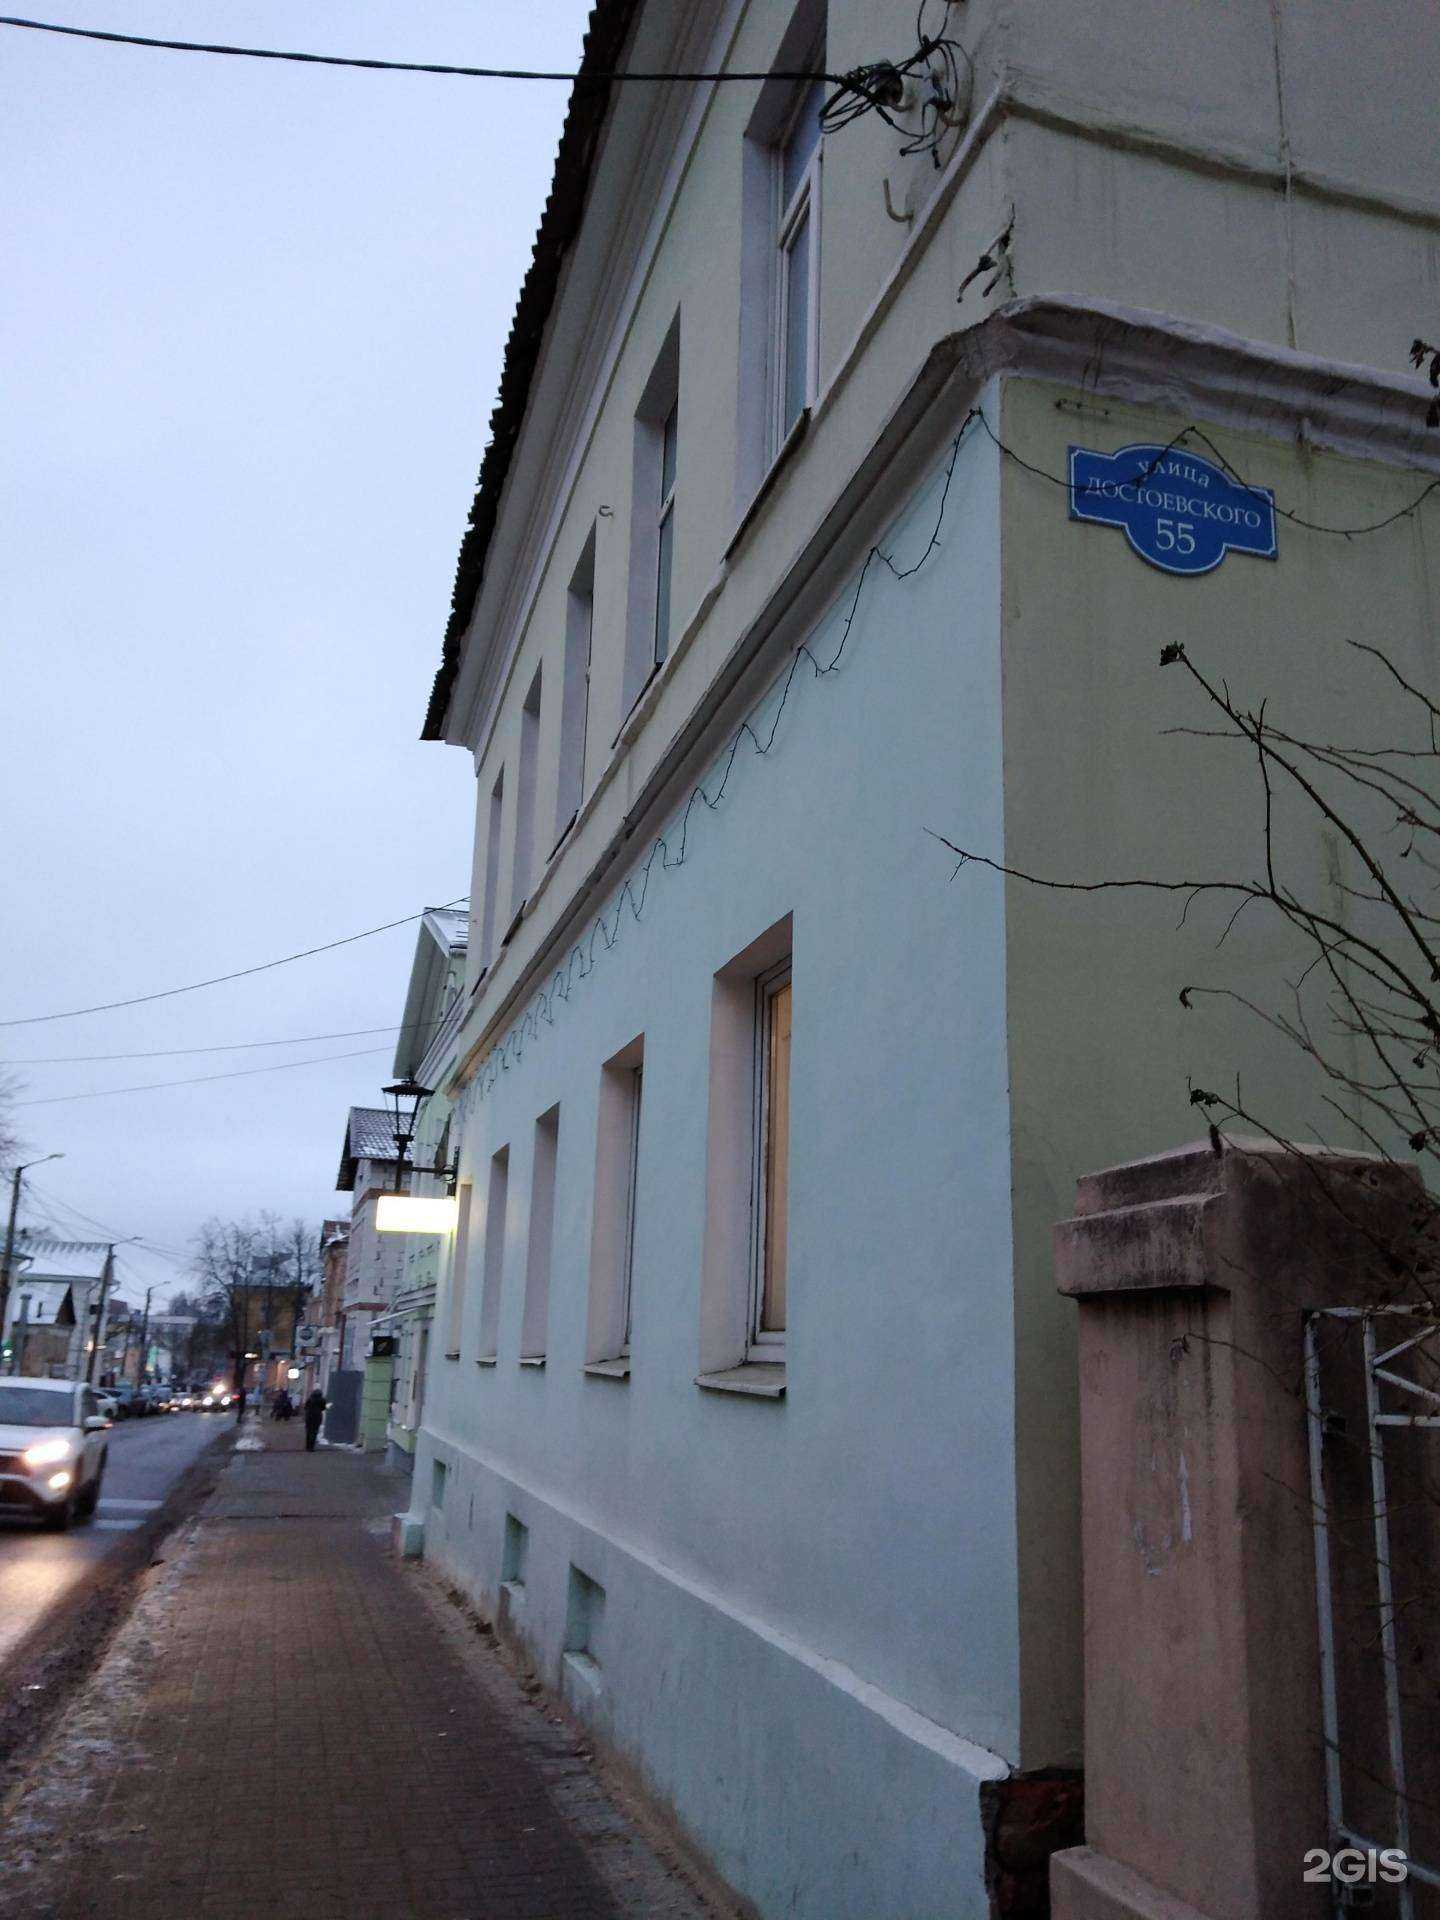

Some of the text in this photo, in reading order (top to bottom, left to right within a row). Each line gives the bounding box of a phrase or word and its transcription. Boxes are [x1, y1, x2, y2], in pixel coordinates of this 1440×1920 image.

[1137, 461, 1211, 488] улица
[1084, 476, 1262, 529] ДОСТОЕВСКОГО
[1155, 518, 1196, 555] 55
